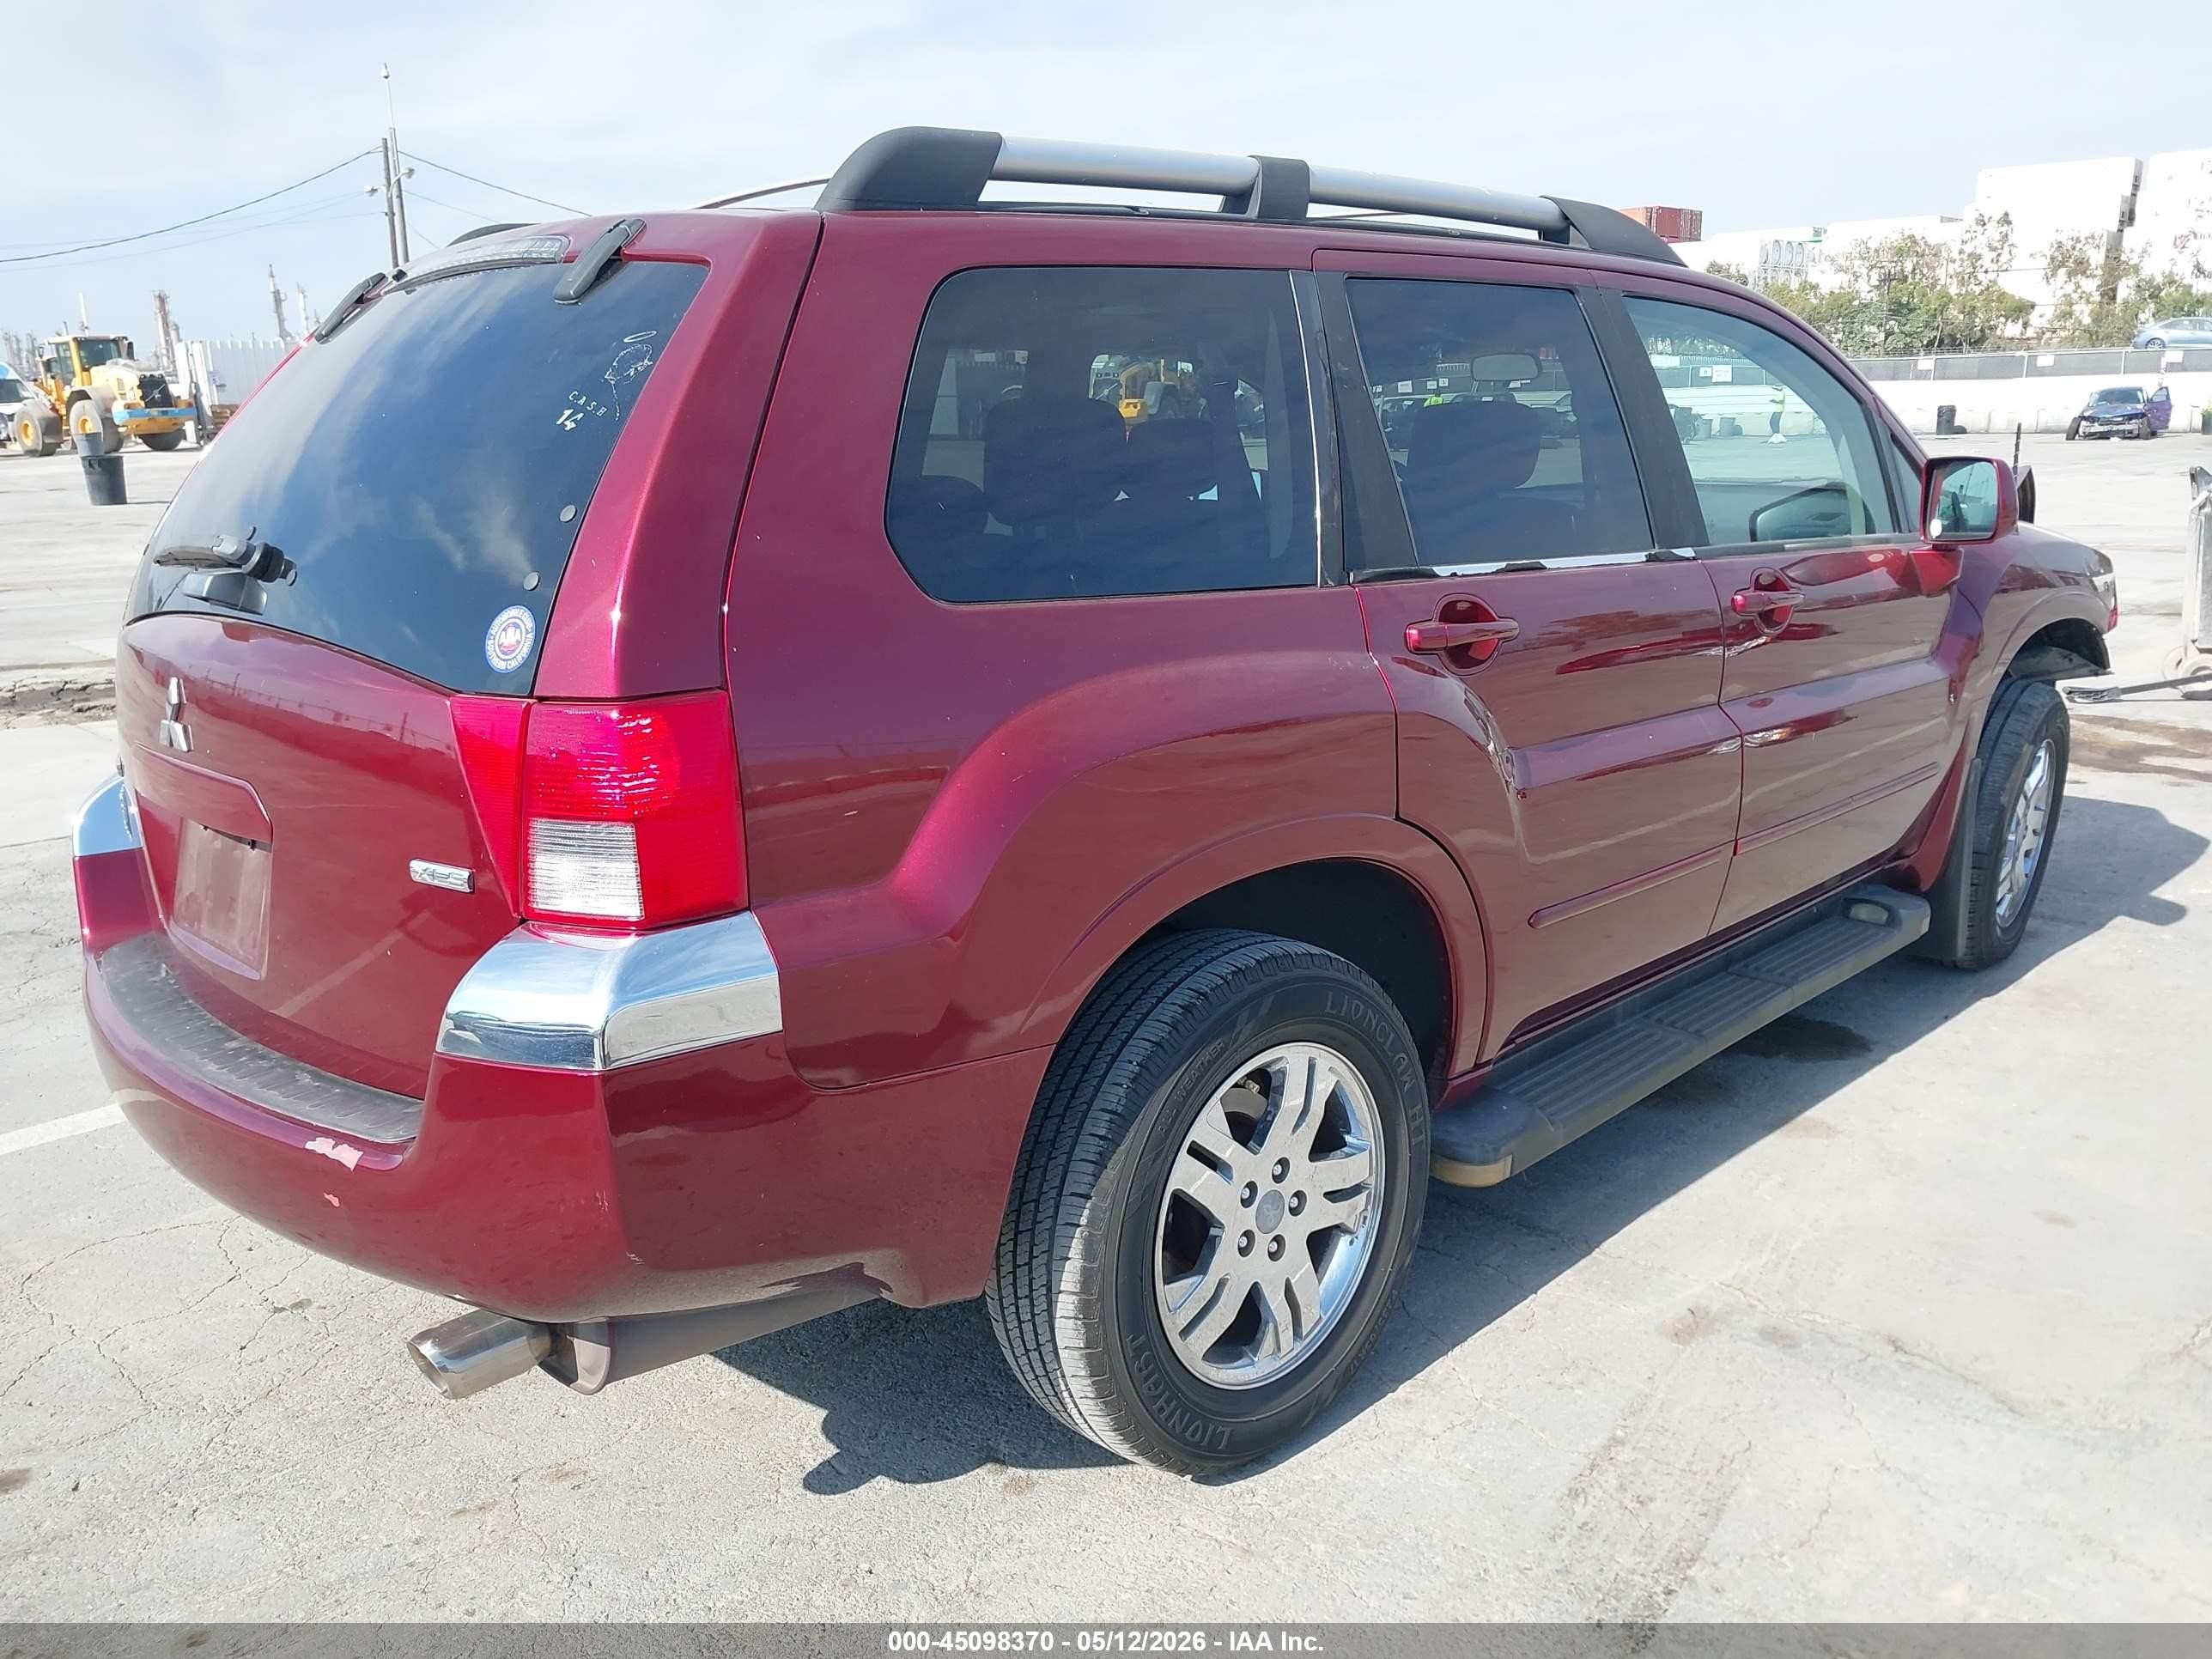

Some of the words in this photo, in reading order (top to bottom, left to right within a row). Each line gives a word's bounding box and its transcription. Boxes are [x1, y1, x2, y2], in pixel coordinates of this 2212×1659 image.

[556, 409, 584, 430] 14
[1157, 1108, 1177, 1133] ALL
[1174, 1038, 1225, 1102] WEATHER
[1325, 992, 1415, 1093] LIONCLAW
[1126, 1334, 1234, 1449] LIONHART
